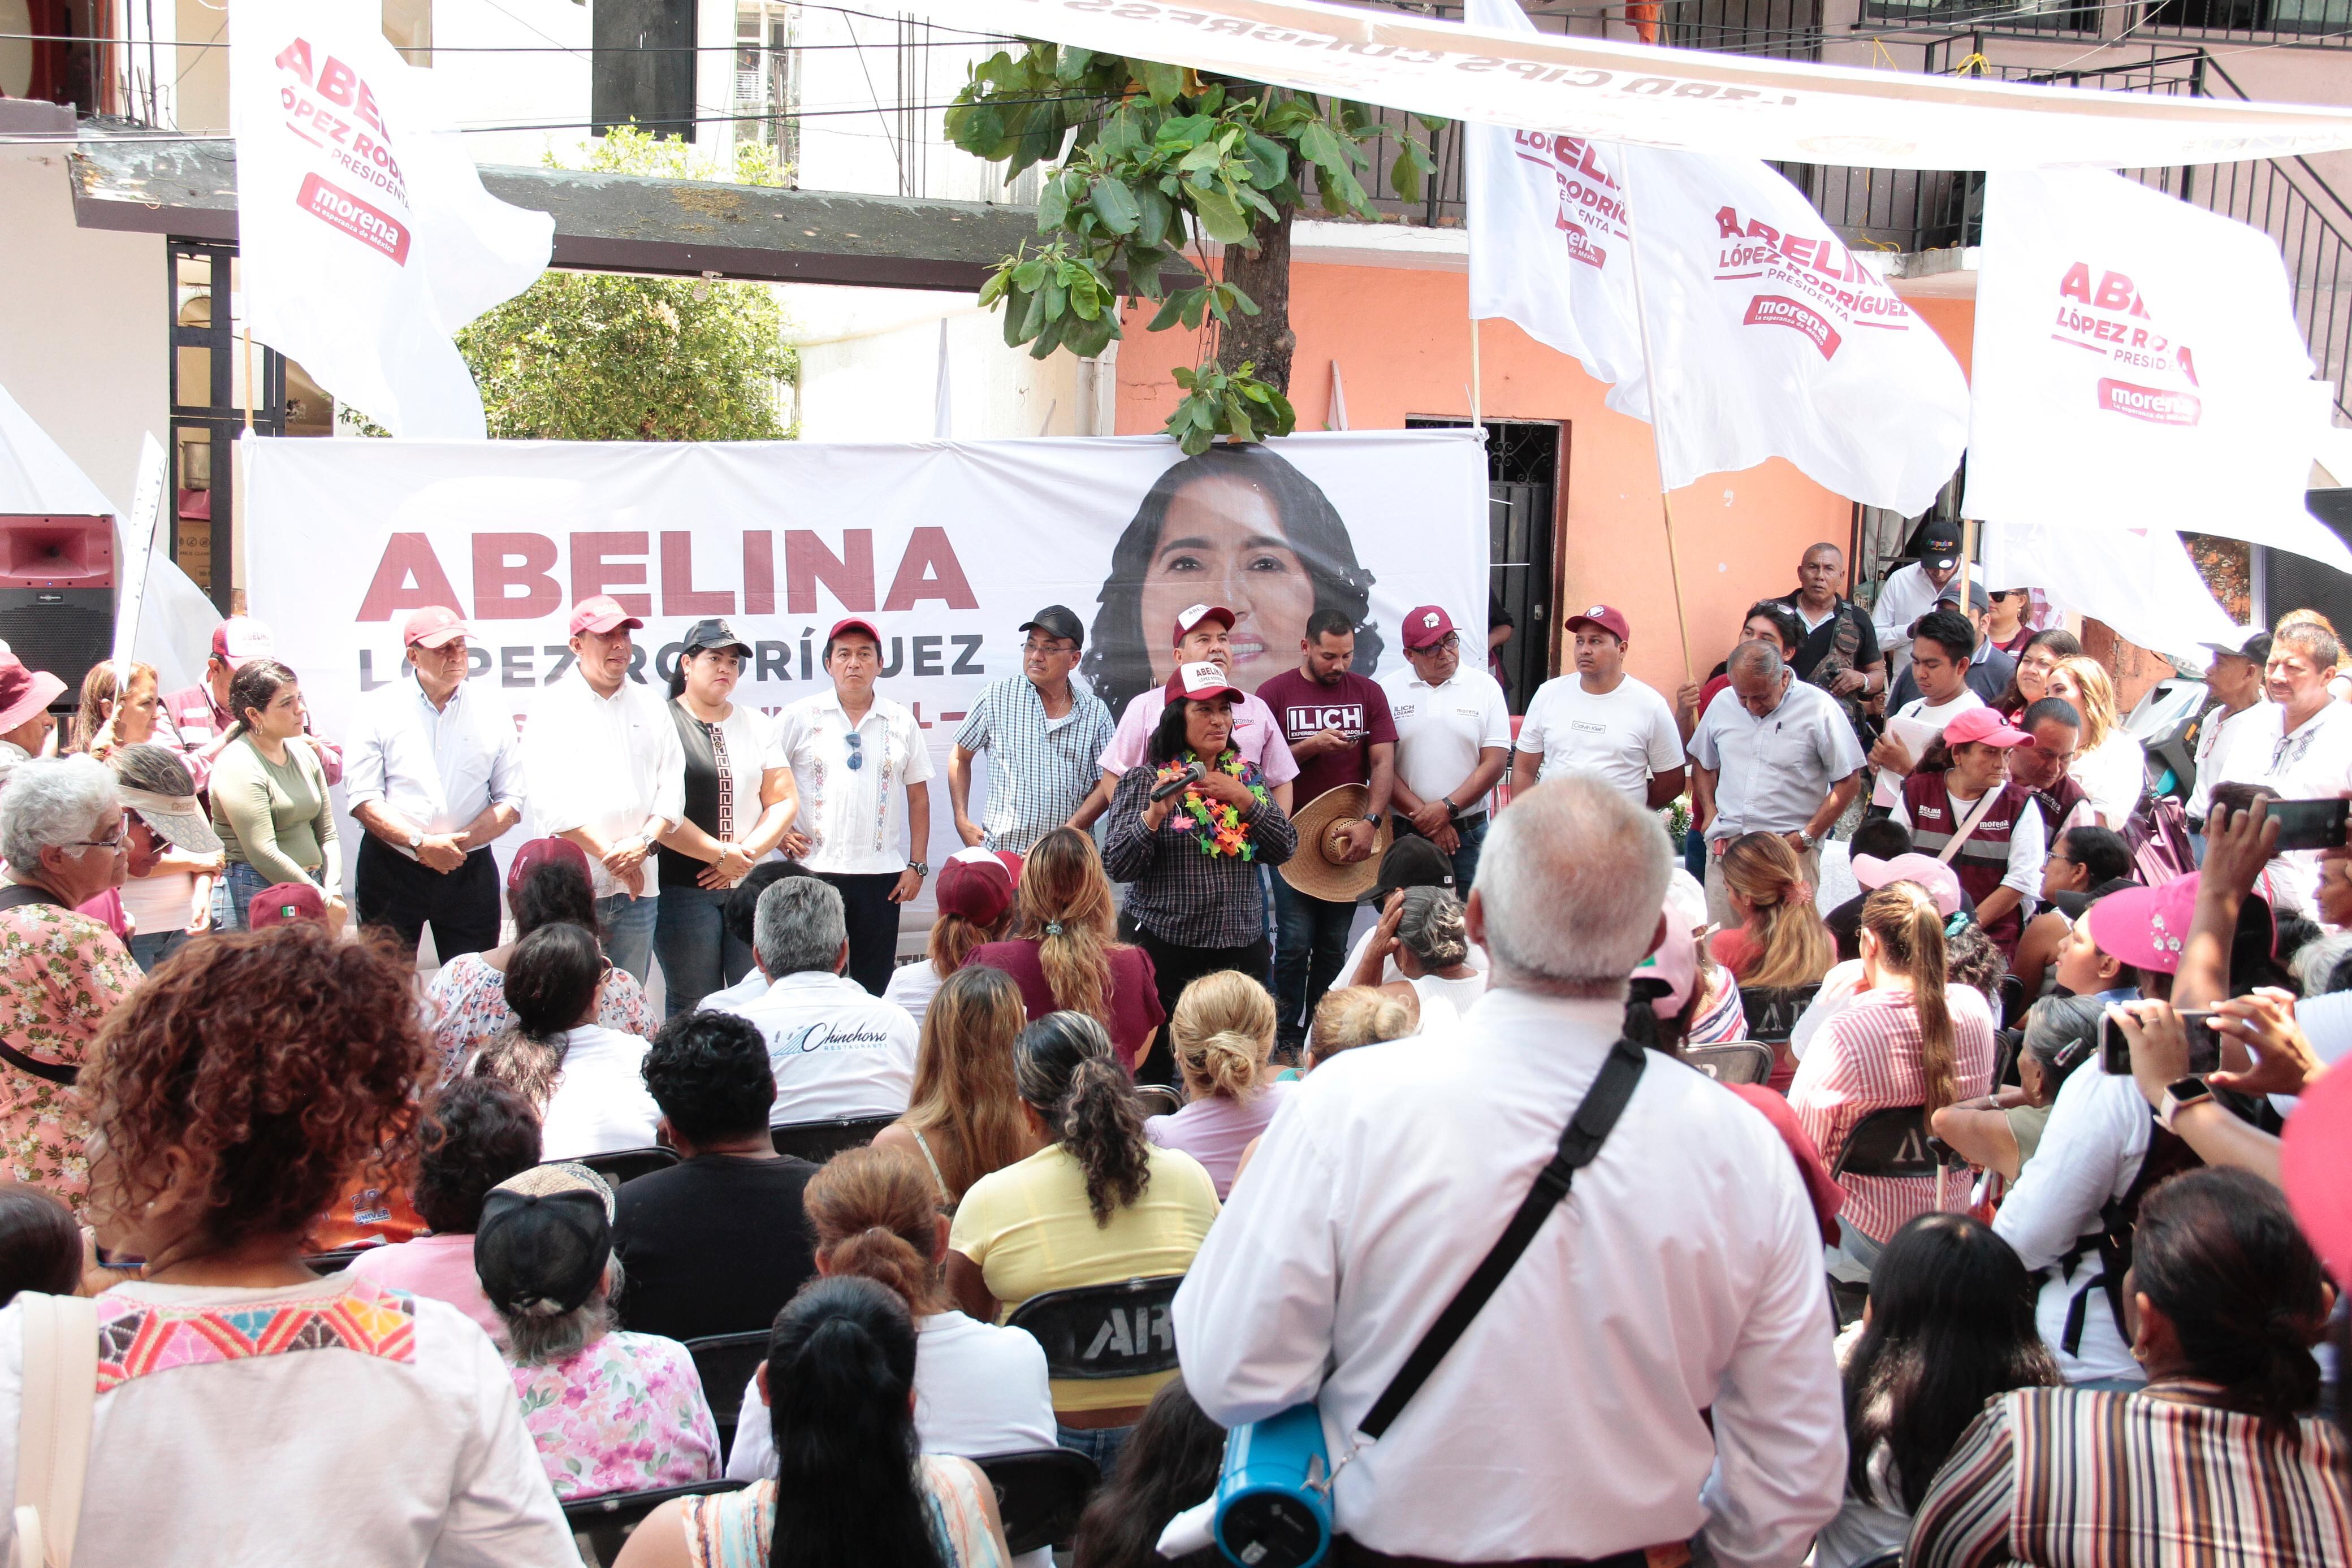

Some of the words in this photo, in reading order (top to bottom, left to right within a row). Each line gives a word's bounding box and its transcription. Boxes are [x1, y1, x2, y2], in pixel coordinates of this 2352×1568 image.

[281, 85, 352, 145] ÓPEZ
[312, 202, 321, 213] La
[322, 207, 358, 232] esperanza
[358, 229, 369, 239] de
[369, 233, 395, 253] México
[315, 187, 399, 246] morena
[1719, 243, 1782, 268] LÓPEZ
[1786, 261, 1909, 317] RODRÍGUEZ
[1767, 267, 1849, 323] PRESIDENTA
[1757, 301, 1828, 341] morena
[1762, 315, 1795, 324] esperanza
[1805, 327, 1824, 346] México
[2056, 306, 2128, 344] LÓPEZ
[354, 526, 980, 622] ABELINA
[1290, 707, 1361, 730] ILICH
[1919, 805, 1941, 815] BELINA
[801, 1021, 888, 1052] Chinchorro
